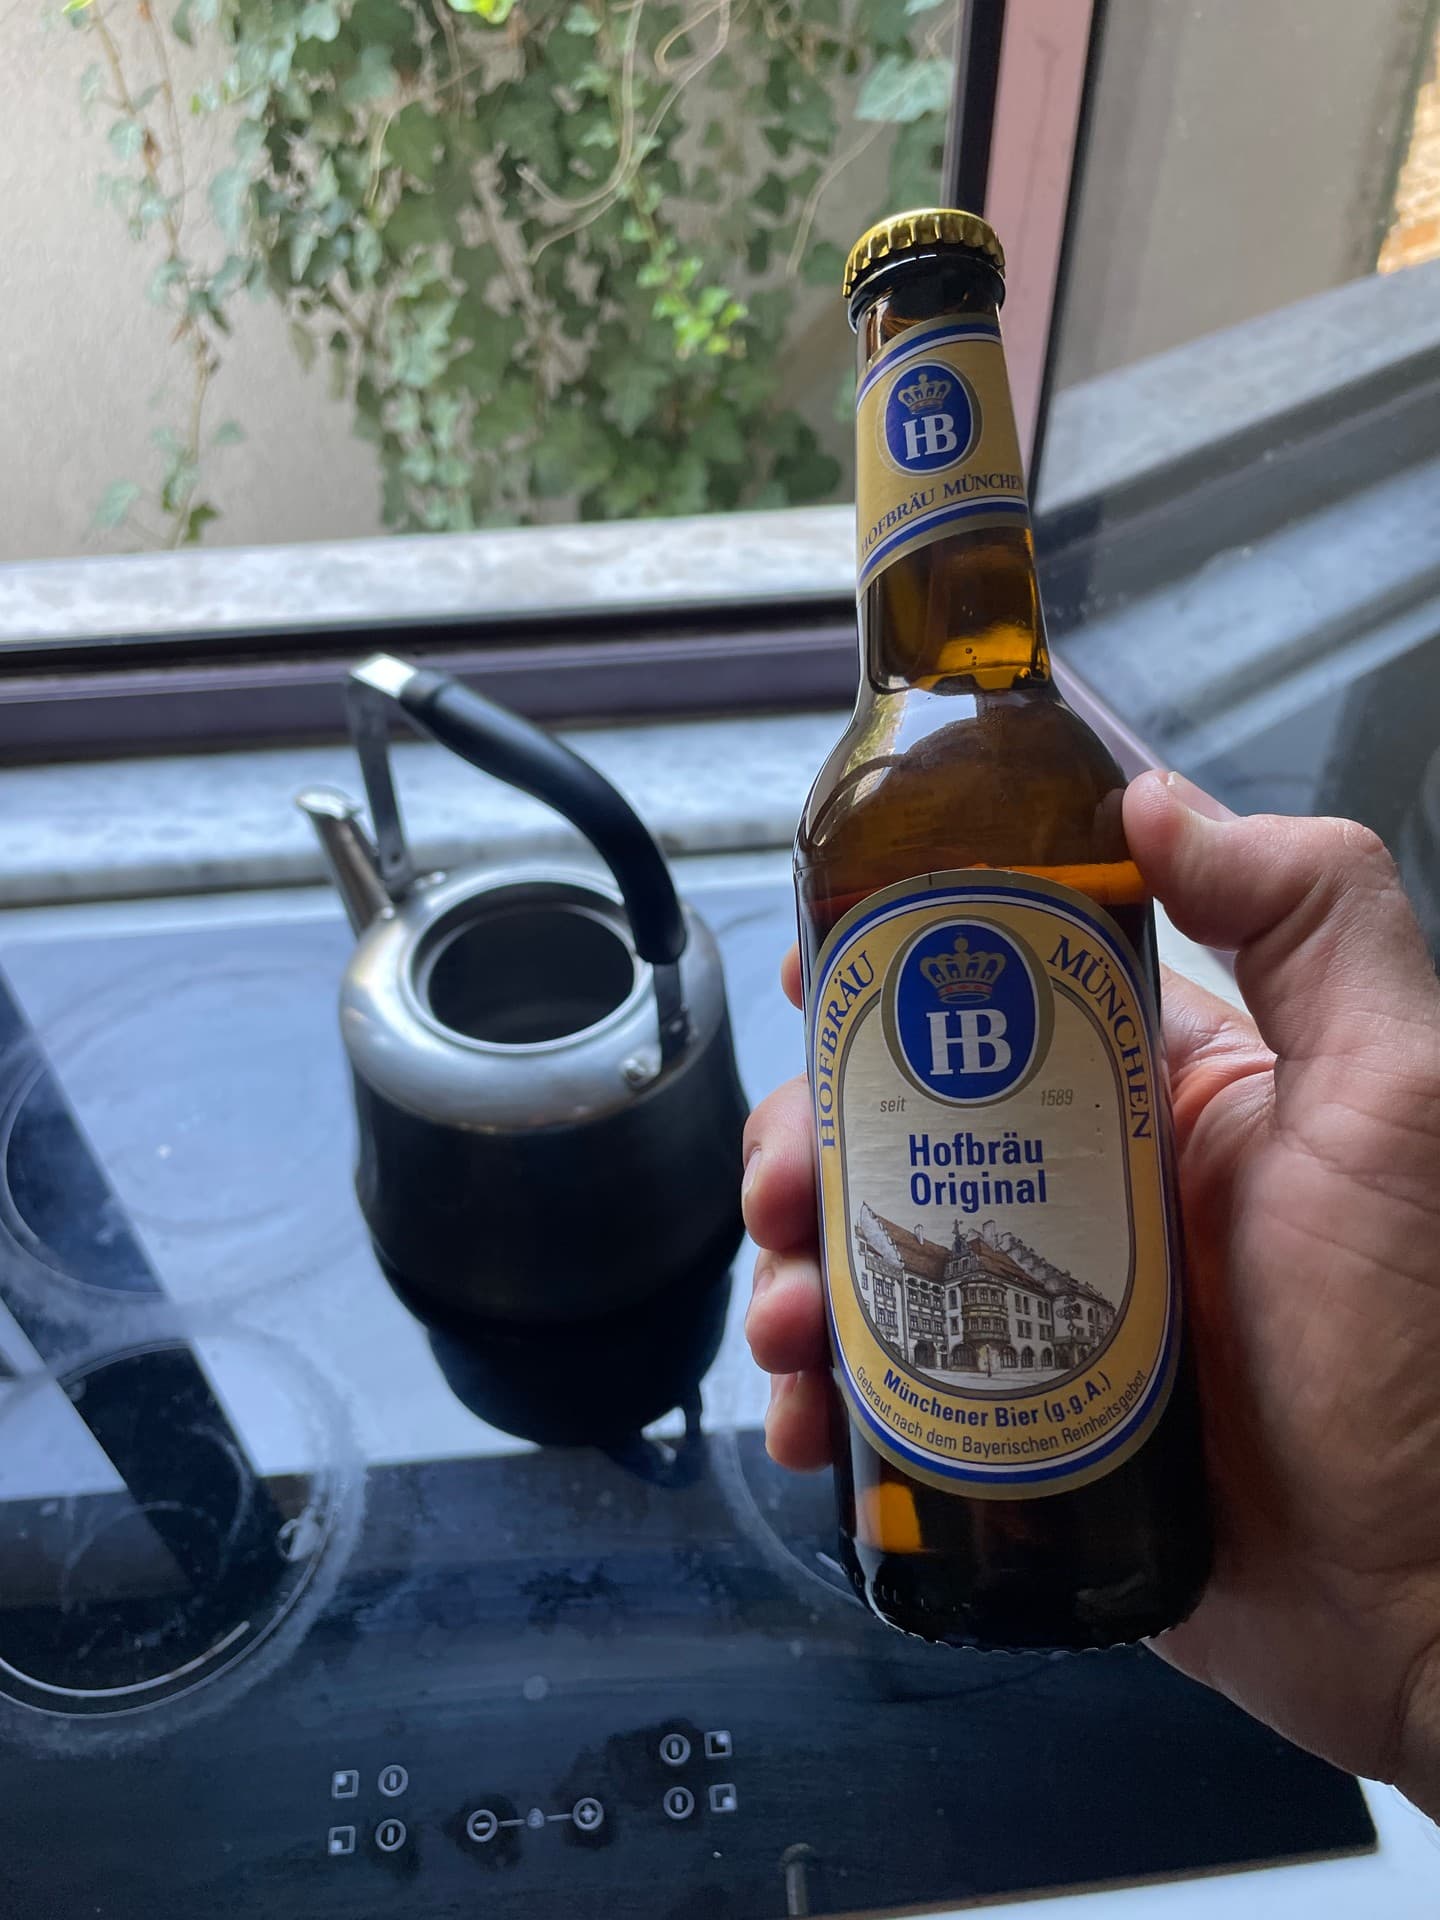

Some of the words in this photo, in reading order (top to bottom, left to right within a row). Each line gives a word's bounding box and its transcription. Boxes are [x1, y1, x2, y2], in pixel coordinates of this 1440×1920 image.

[904, 414, 957, 461] HB
[861, 489, 935, 554] HOFBRÄU
[818, 951, 876, 1149] HOFBRÄU
[1047, 935, 1153, 1139] MÜNCHEN
[926, 1008, 1012, 1076] HB
[880, 1097, 906, 1113] seit
[1041, 1089, 1073, 1106] 1589
[909, 1132, 1043, 1167] Hofbräu
[910, 1170, 1047, 1213] Original
[856, 1366, 891, 1418] Gebraut
[893, 1411, 923, 1438] nach
[926, 1429, 957, 1450] dem
[962, 1435, 1059, 1458] Bayerischen
[1062, 1370, 1147, 1443] Reinheitsgebot
[884, 1368, 988, 1427] Münchener
[995, 1406, 1039, 1427] Bier
[1044, 1371, 1112, 1423] (g.g.A.)
